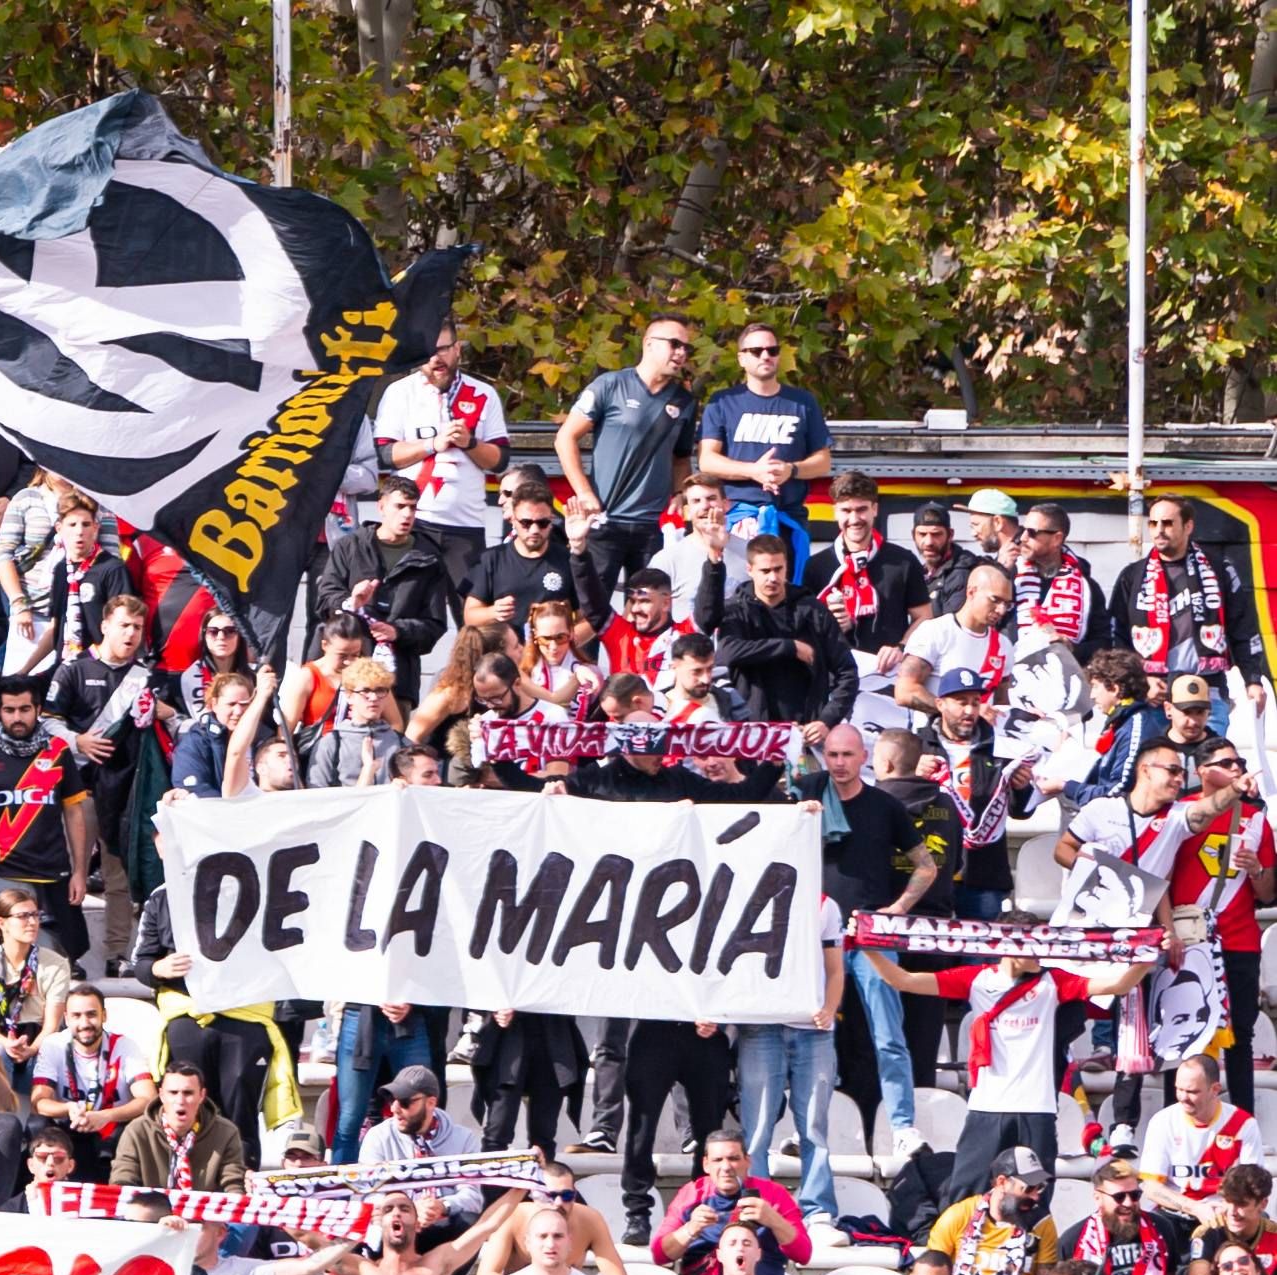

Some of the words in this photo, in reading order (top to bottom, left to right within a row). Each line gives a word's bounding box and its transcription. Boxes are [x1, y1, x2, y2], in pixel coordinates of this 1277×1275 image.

[732, 412, 800, 445] NIKE
[193, 842, 320, 962] DE
[344, 839, 449, 957] LA
[468, 811, 797, 979] MARÍA
[870, 914, 1086, 942] MALDITOS
[49, 1182, 130, 1219] EL
